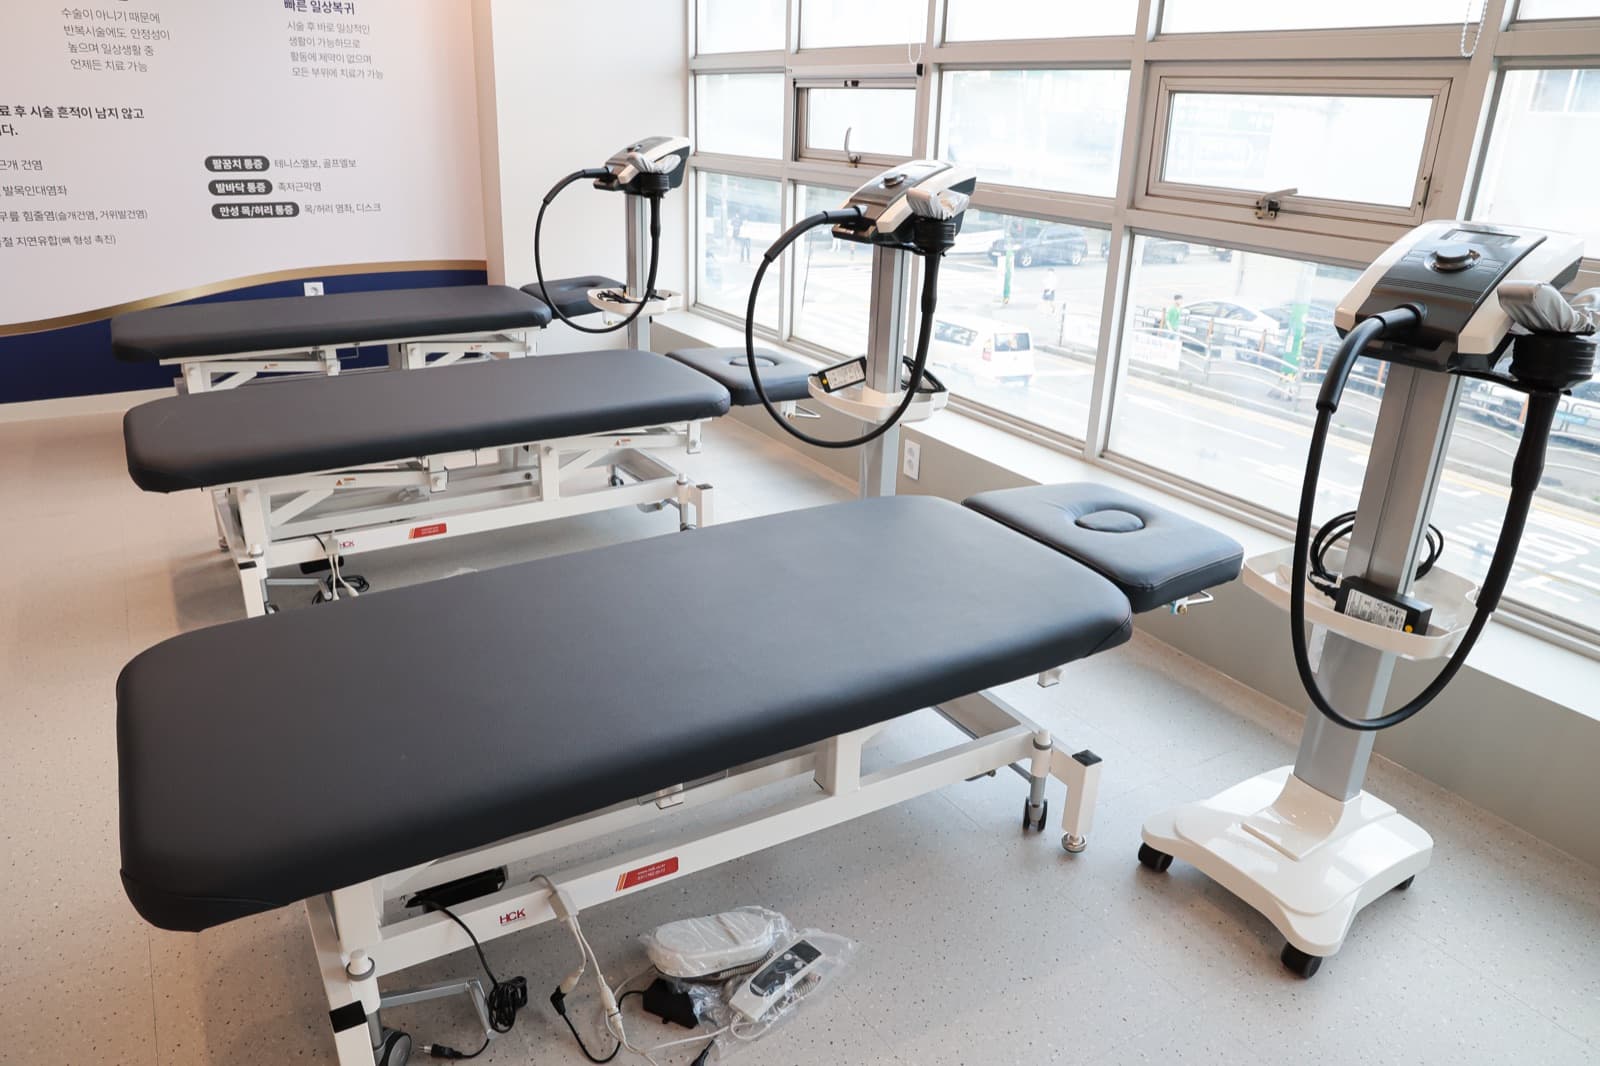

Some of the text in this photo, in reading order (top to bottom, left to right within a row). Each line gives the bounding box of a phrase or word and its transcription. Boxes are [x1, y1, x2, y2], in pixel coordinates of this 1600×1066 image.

[284, 0, 355, 15] 빠른 일상복귀
[61, 8, 161, 24] 수술이 아니기 때문에
[63, 24, 171, 40] 반복시술에도 안정성이
[70, 58, 148, 72] 언제든 치료 가능
[14, 104, 27, 118] 후
[30, 104, 54, 119] 시술
[57, 106, 93, 119] 흔적이
[95, 107, 119, 120] 남지
[121, 107, 145, 120] 않고
[0, 123, 18, 136] 다.
[20, 159, 43, 171] 건염
[2, 184, 67, 197] 발목인대염좌
[0, 236, 14, 248] 절
[499, 908, 526, 925] HCK
